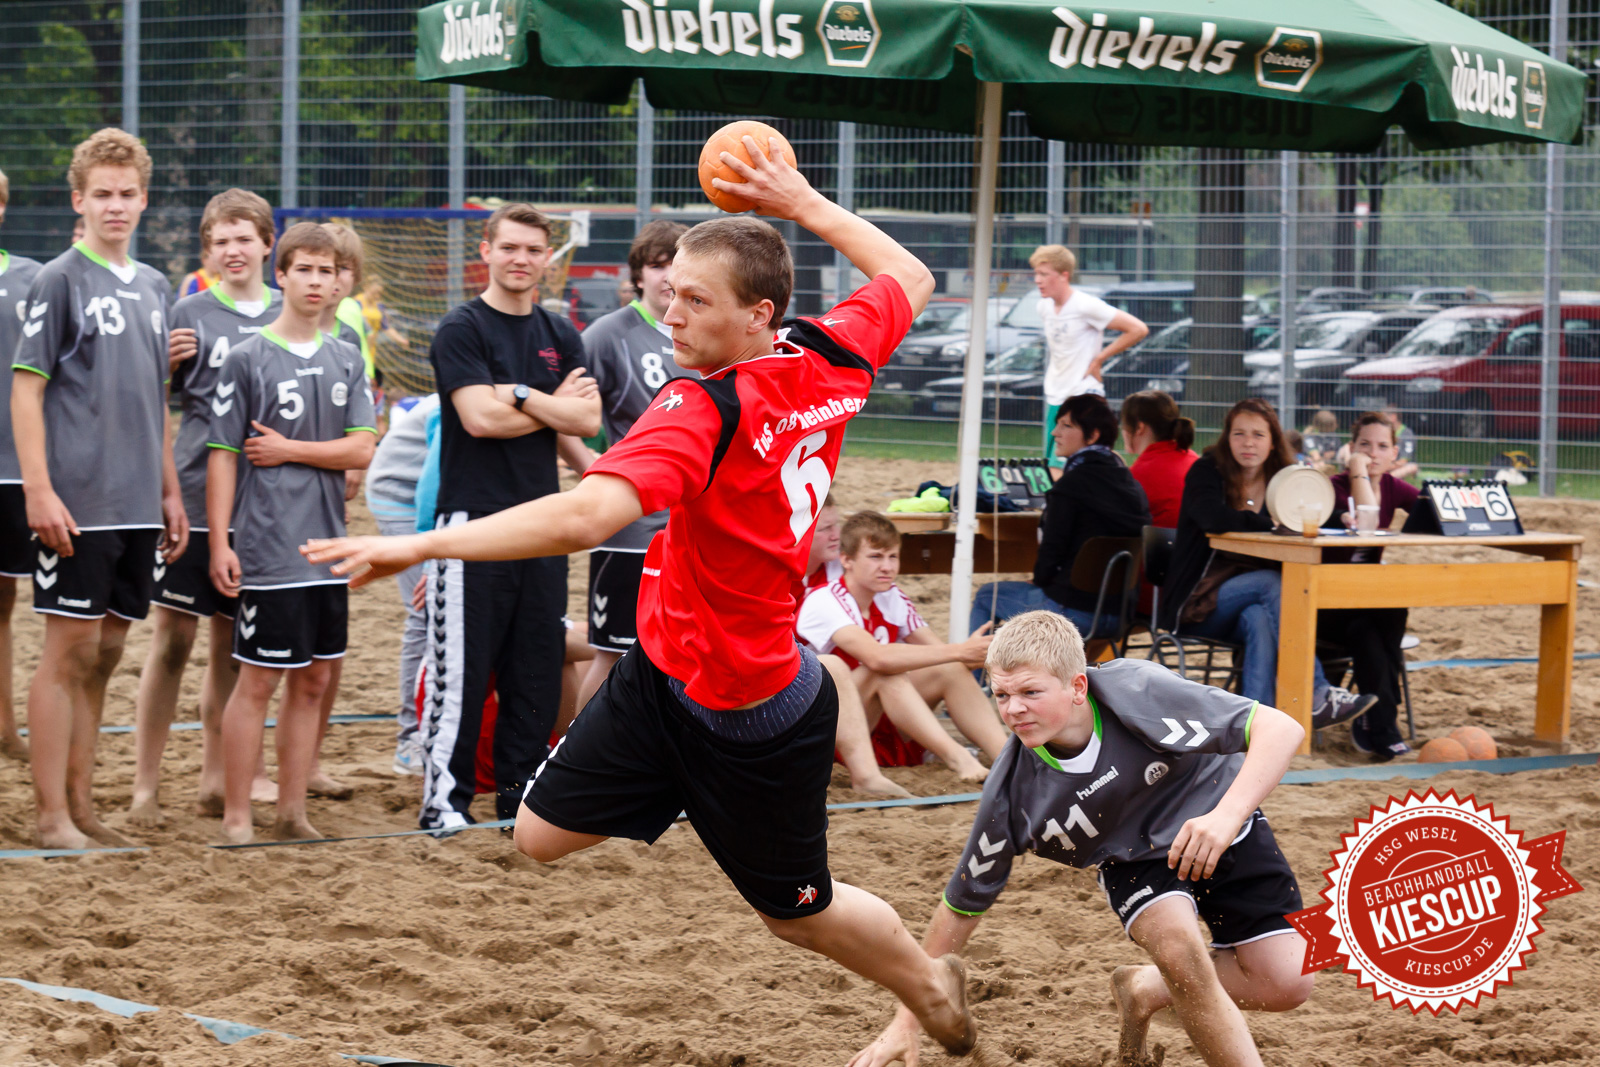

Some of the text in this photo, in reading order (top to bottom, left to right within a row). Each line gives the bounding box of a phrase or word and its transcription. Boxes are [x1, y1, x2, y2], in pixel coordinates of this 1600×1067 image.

[85, 296, 126, 335] 13
[641, 353, 667, 389] 8
[277, 379, 304, 420] 5
[753, 422, 774, 459] TuS
[775, 411, 798, 435] 08
[780, 429, 831, 547] 6
[981, 465, 1003, 493] 6
[1023, 466, 1054, 494] 13
[1441, 491, 1460, 517] 4
[1486, 491, 1508, 517] 6
[1076, 765, 1120, 801] hummel
[1041, 803, 1100, 851] 11
